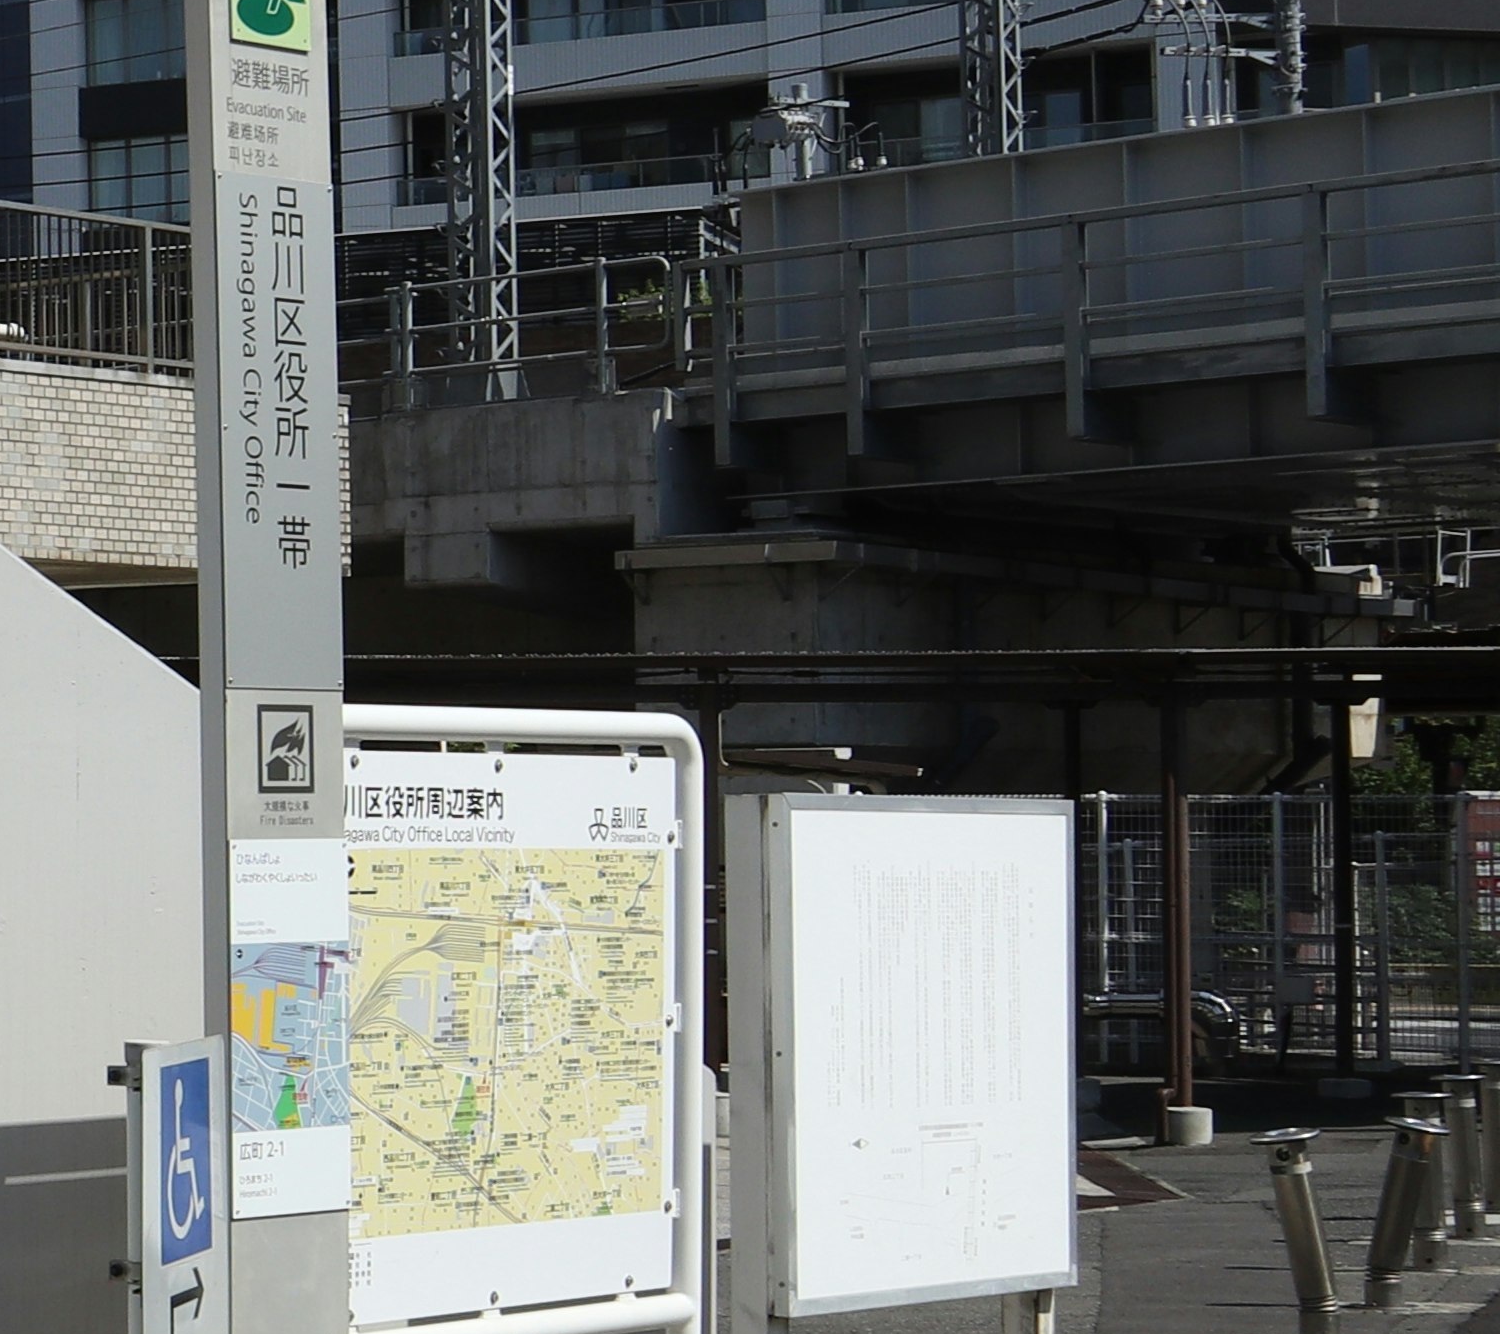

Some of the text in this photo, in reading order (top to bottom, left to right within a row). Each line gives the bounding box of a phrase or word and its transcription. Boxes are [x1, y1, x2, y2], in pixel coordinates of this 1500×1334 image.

[232, 58, 310, 97] 避難場所
[226, 97, 307, 124] Evacuation Site
[228, 146, 279, 168] 피난장소
[238, 193, 264, 524] Shinagawa City Office
[611, 807, 648, 829] 品川区
[382, 826, 405, 843] City
[408, 826, 443, 842] Office
[445, 826, 474, 842] Local
[476, 826, 515, 844] Vicinity
[610, 832, 661, 844] Shinagawa City
[240, 1140, 285, 1160] 広町 2-1
